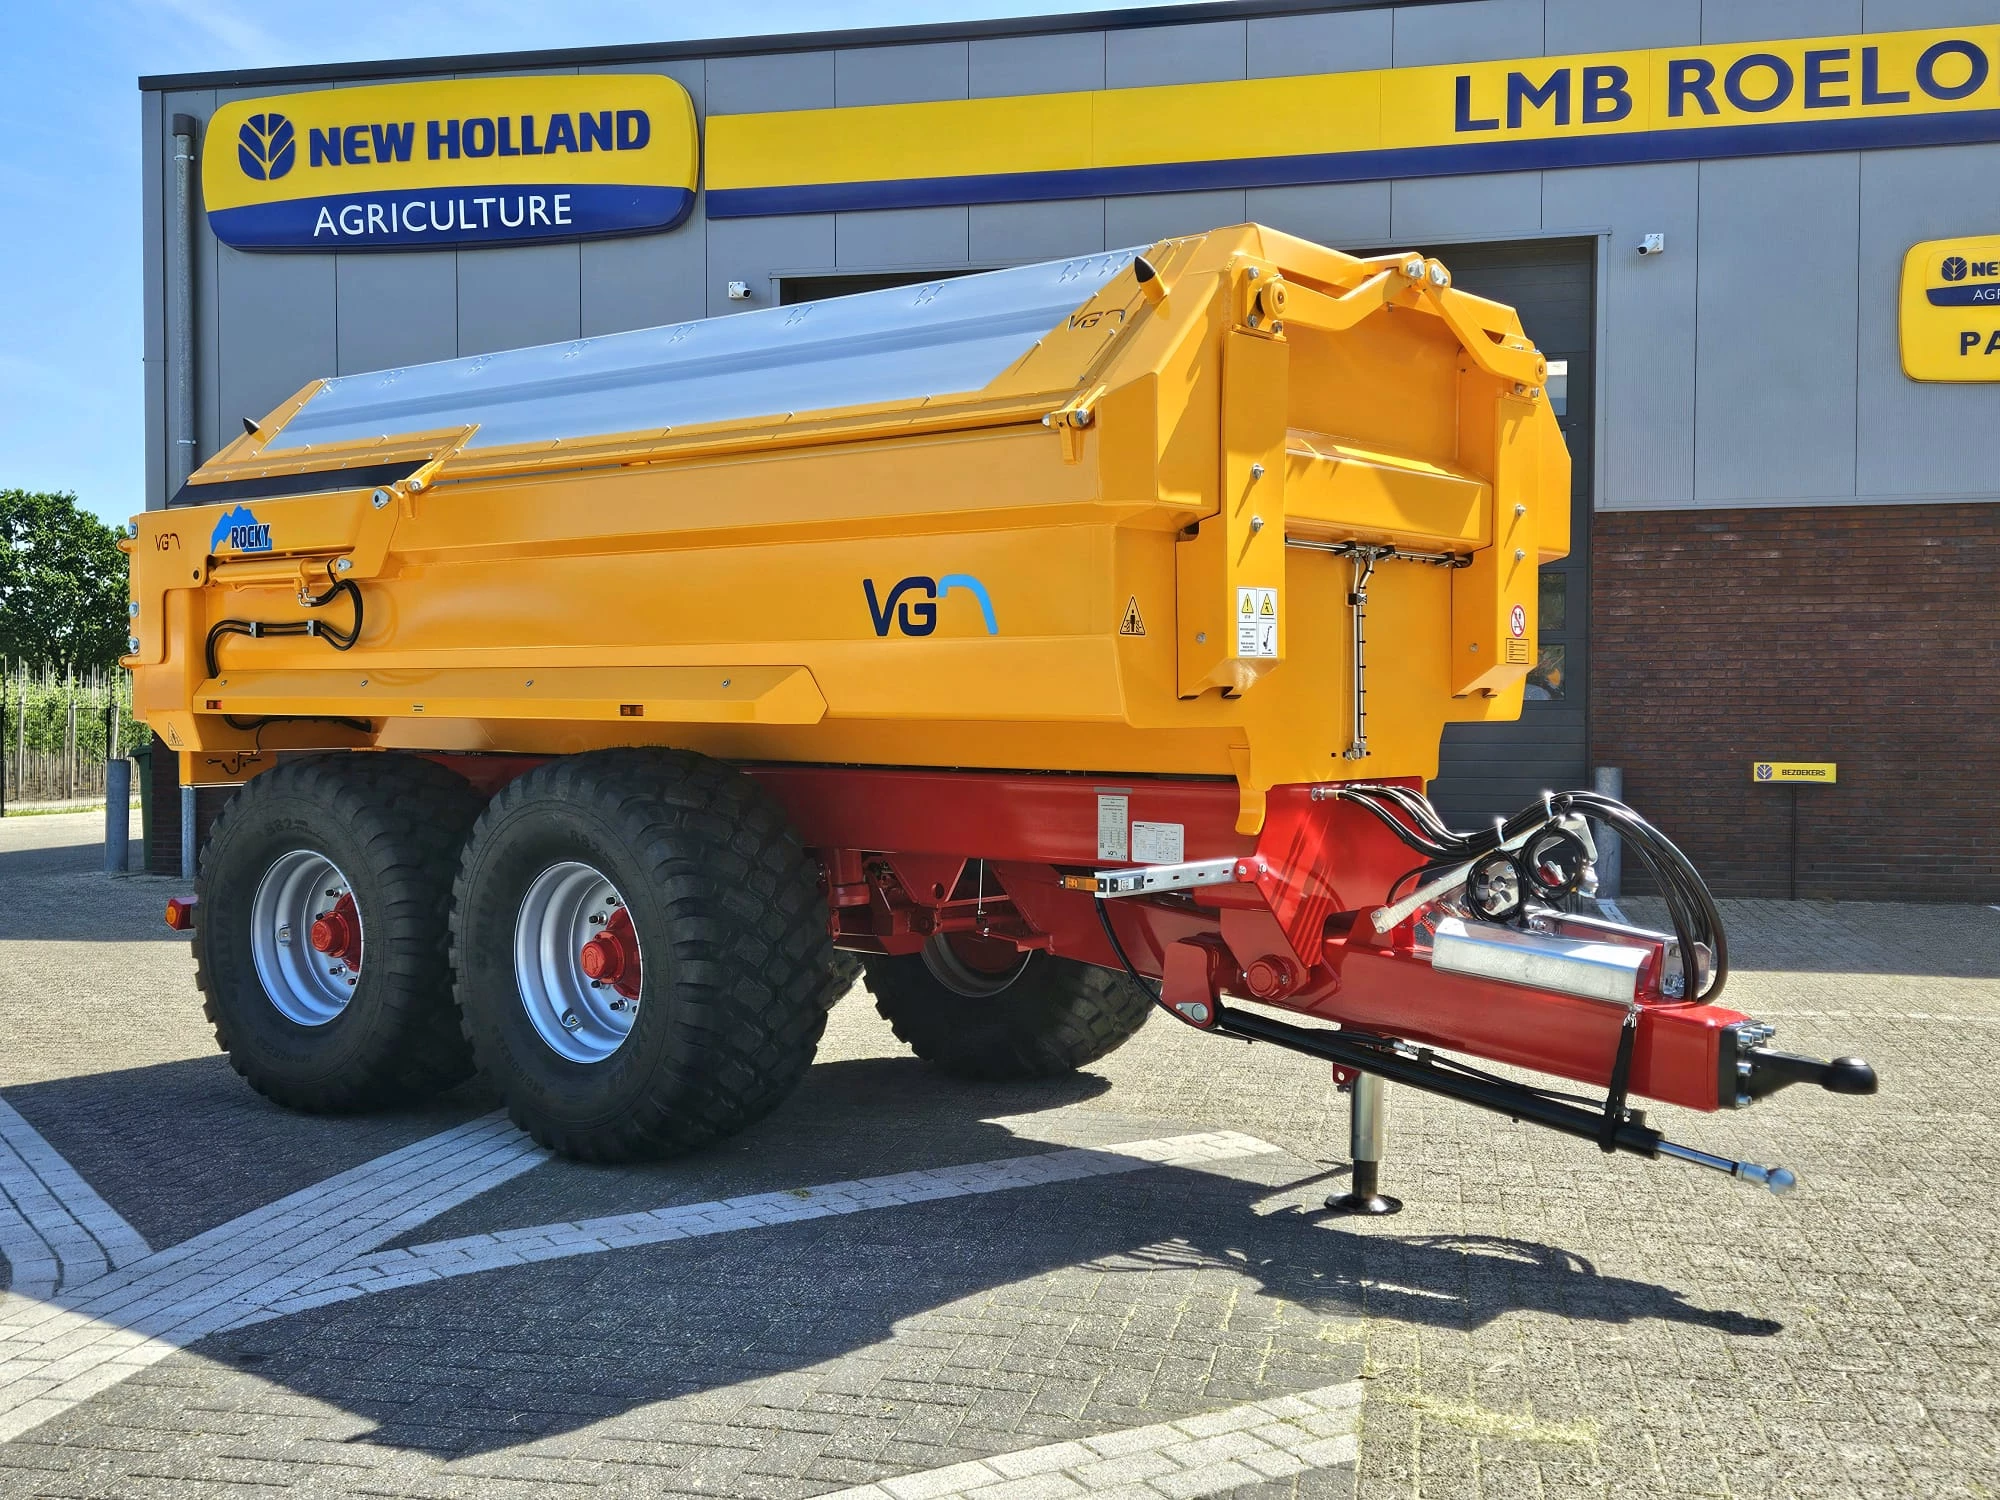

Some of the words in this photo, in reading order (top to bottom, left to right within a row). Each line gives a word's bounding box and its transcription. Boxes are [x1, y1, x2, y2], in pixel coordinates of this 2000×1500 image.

[1455, 65, 1633, 132] LMB
[1667, 40, 1989, 118] ROELO
[309, 122, 415, 168] NEW
[427, 109, 651, 160] HOLLAND
[313, 194, 573, 237] AGRICULTURE
[1971, 261, 2000, 277] NE
[231, 524, 271, 549] ROCKY
